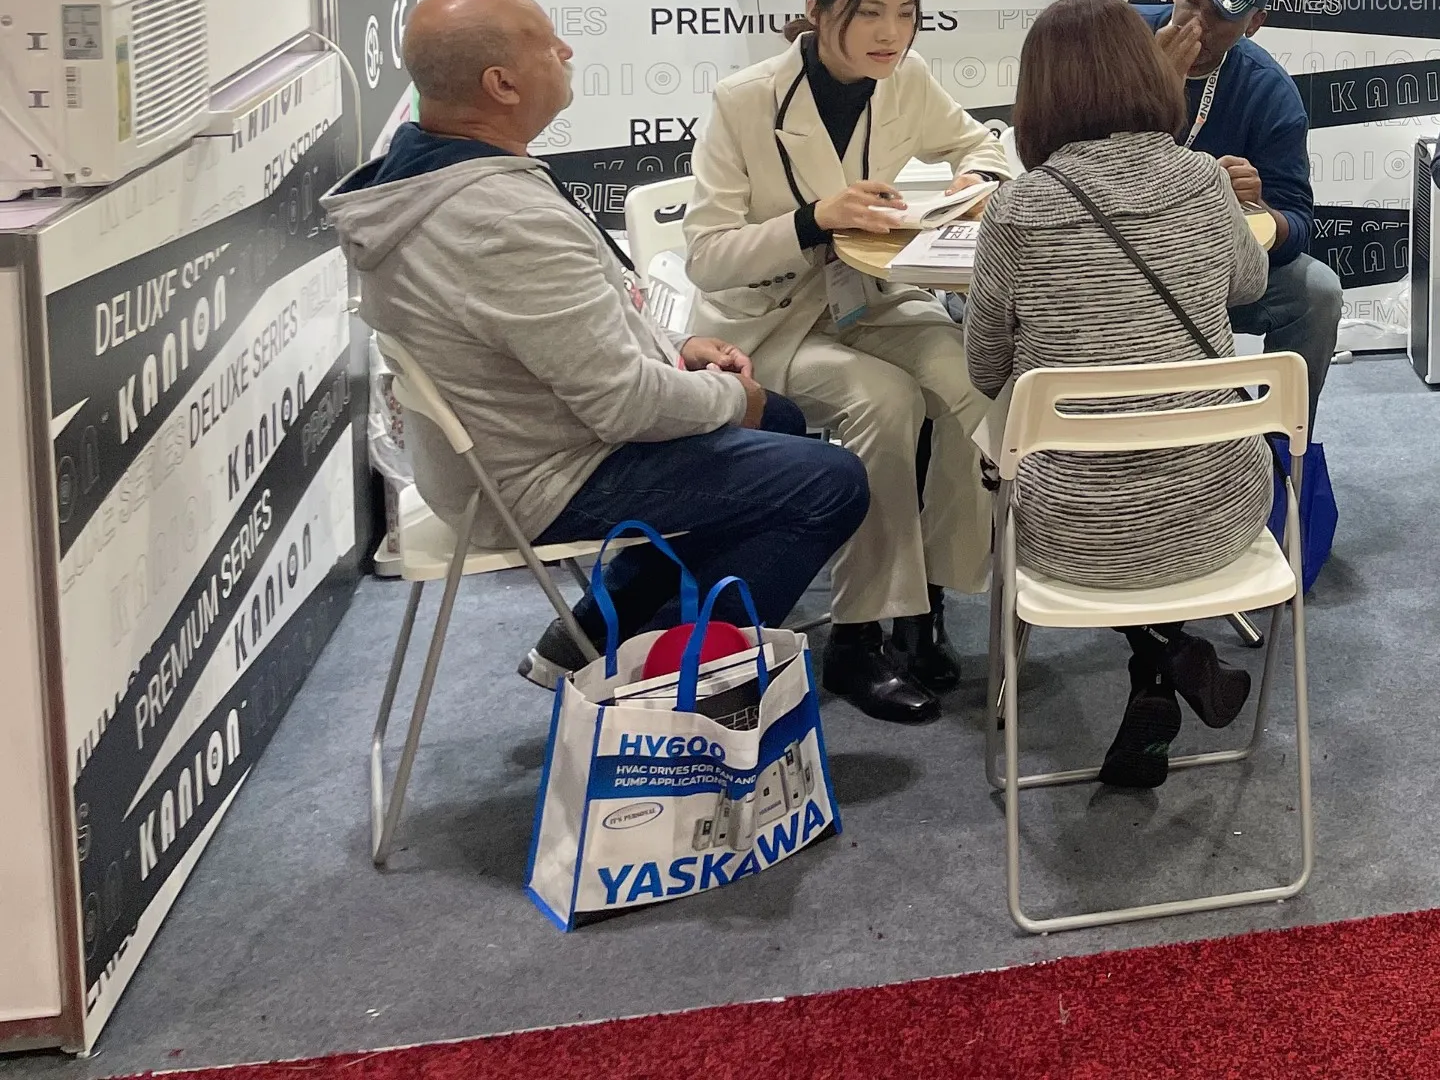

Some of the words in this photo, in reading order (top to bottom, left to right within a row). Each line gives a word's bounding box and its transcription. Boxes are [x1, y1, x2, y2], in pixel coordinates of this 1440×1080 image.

[118, 275, 227, 445] KANION
[189, 348, 251, 450] DELUXE
[252, 299, 298, 380] SERIES
[228, 371, 307, 502] KANION
[135, 586, 221, 750] PREMIUM
[221, 487, 273, 601] SERIES
[232, 522, 312, 675] KANION
[139, 707, 243, 882] KANION
[614, 777, 647, 788] PUMP
[648, 775, 728, 788] APPLICATIONS
[616, 765, 647, 775] HVAC
[649, 765, 690, 775] DRIVES
[691, 764, 713, 773] FOR
[734, 775, 757, 785] AND
[619, 733, 726, 763] HV600
[597, 798, 826, 905] YASKAWA
